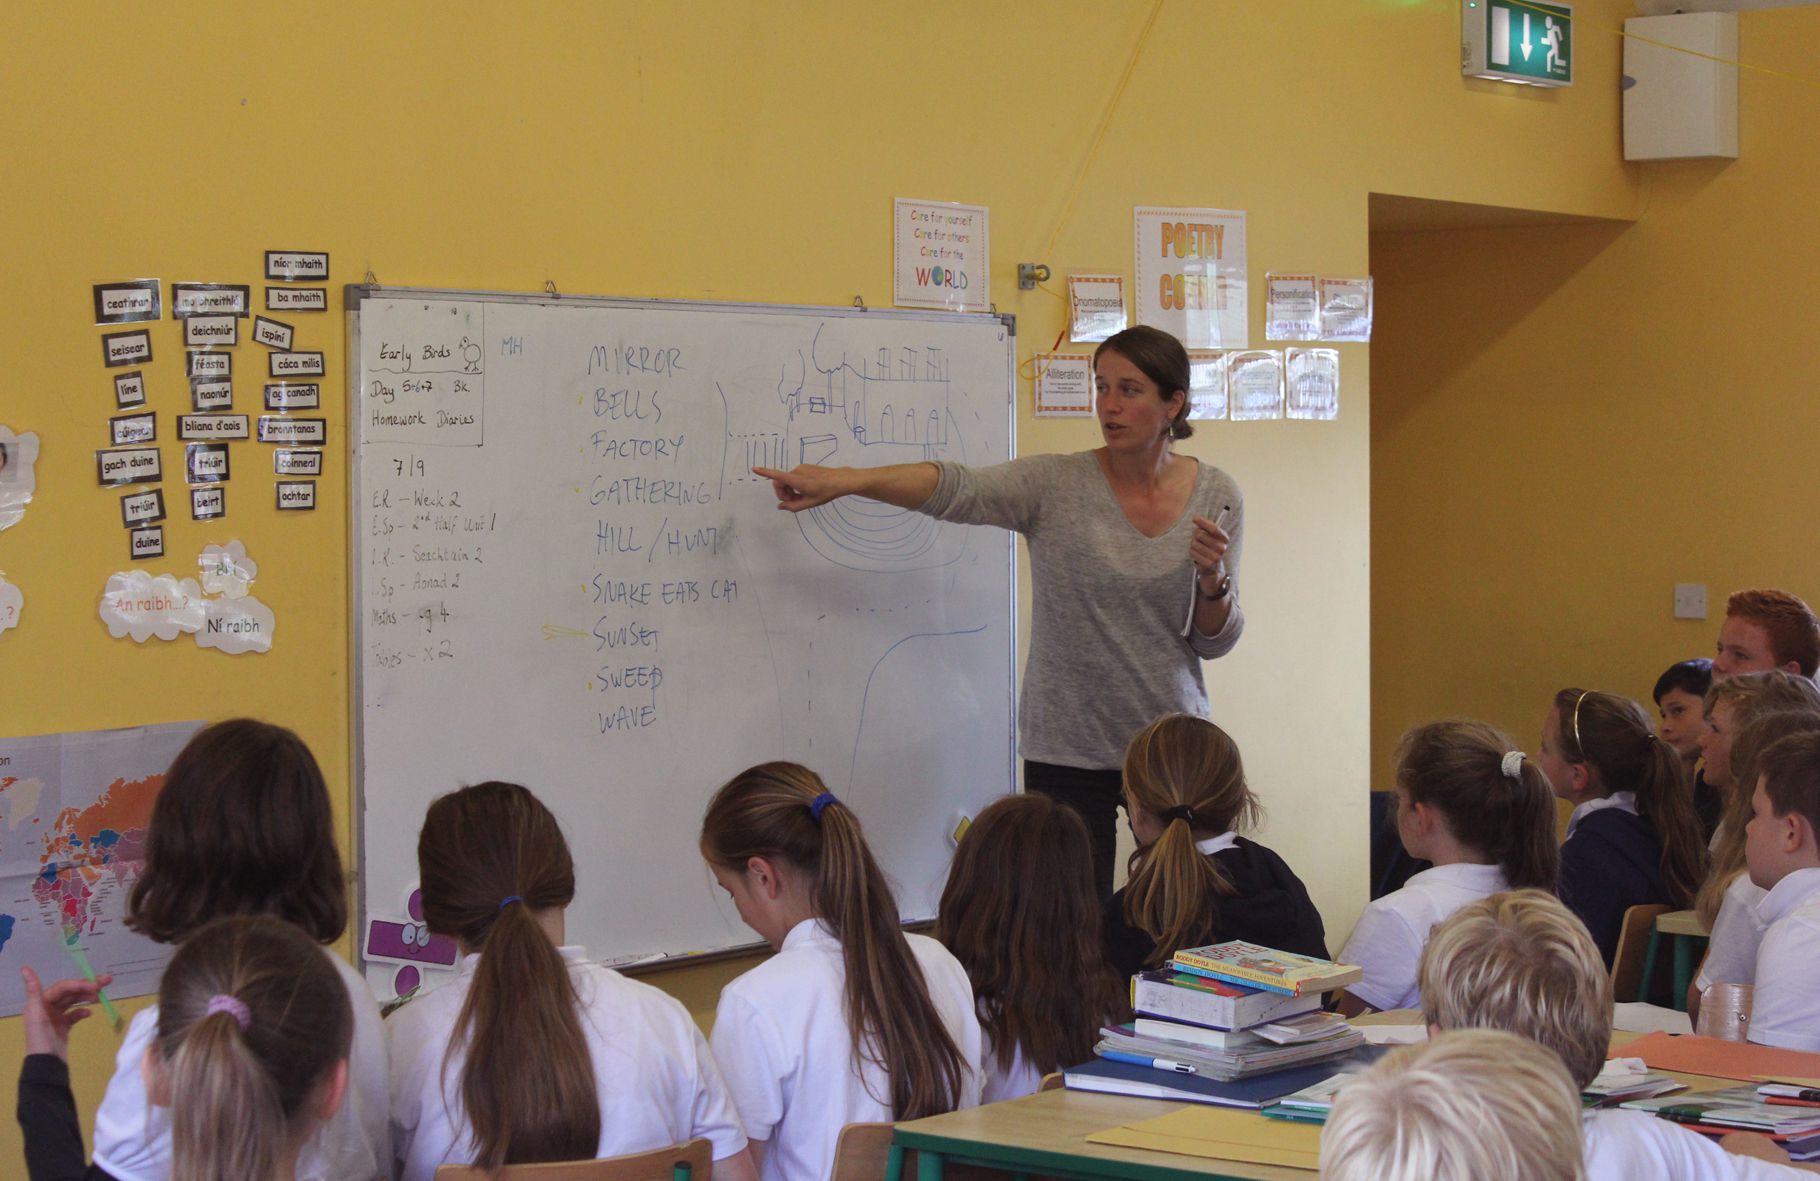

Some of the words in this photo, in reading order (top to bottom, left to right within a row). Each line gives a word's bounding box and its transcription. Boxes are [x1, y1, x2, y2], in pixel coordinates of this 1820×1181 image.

[911, 209, 929, 222] Care
[931, 211, 943, 224] for
[914, 228, 932, 240] Care
[934, 229, 946, 241] for
[1161, 222, 1224, 260] POETRY
[920, 246, 938, 258] Care
[939, 247, 952, 259] for
[916, 265, 968, 290] WORLD
[278, 292, 289, 302] ba
[292, 292, 322, 303] mhaith
[191, 324, 234, 336] deichniúr
[261, 327, 286, 343] ispíní
[501, 336, 523, 356] MH
[195, 358, 225, 370] féasta
[278, 357, 299, 369] cáca
[302, 358, 321, 368] milis
[379, 342, 411, 372] Early
[422, 344, 451, 360] Birds
[588, 345, 687, 378] MIRROR
[1046, 368, 1085, 380] Alliteration
[121, 384, 138, 396] líne
[200, 387, 230, 400] naonúr
[286, 385, 316, 398] canadh
[370, 380, 395, 404] Day
[593, 387, 662, 424] BELLS
[185, 420, 213, 431] bliana
[216, 420, 241, 431] d'aois
[372, 410, 427, 428] Homework
[436, 409, 475, 428] Diaries
[590, 430, 685, 464] FACTORY
[104, 458, 127, 473] gach
[130, 456, 154, 469] duine
[281, 491, 311, 502] ochtar
[414, 487, 445, 508] Week
[449, 491, 461, 508] 2
[590, 475, 711, 506] GATHERING
[135, 536, 161, 549] duine
[592, 573, 652, 608] SNAKE
[661, 580, 700, 605] EATS
[711, 578, 738, 604] CAT
[116, 598, 133, 611] An
[440, 601, 450, 623] 4
[207, 617, 223, 634] Ní
[226, 617, 260, 633] raibh
[592, 615, 660, 652] SUNSET
[596, 665, 663, 692] SWEEP
[598, 705, 657, 734] WAVE
